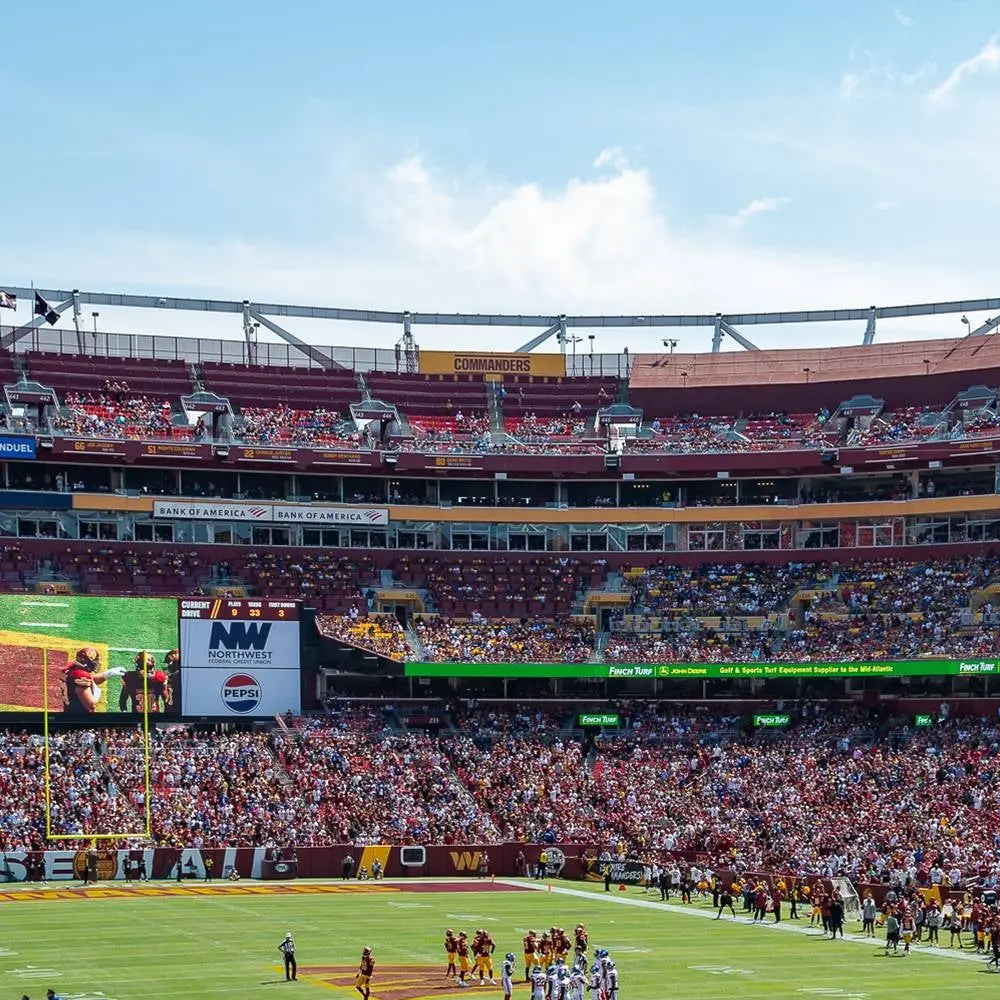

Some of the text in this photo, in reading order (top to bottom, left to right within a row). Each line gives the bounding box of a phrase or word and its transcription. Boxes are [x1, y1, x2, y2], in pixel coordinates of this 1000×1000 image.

[454, 358, 531, 372] COMMANDERS
[0, 443, 33, 453] NDUEL
[75, 441, 85, 450] 66
[160, 507, 186, 515] BANK
[203, 509, 246, 518] AMERICA
[278, 511, 303, 519] BANK
[320, 513, 362, 521] AMERICA
[182, 610, 200, 618] DRIVE
[279, 609, 284, 617] 3
[208, 622, 272, 650] NW
[208, 651, 272, 659] NORTHWEST
[609, 666, 633, 676] FINCH
[634, 665, 653, 675] TURF
[742, 666, 762, 674] Sports
[764, 665, 777, 673] Turf
[779, 665, 812, 674] Equipment
[814, 665, 839, 674] Supplier
[848, 665, 858, 673] the
[860, 664, 893, 673] Mid-Atlantic
[959, 662, 980, 671] FINCH
[980, 661, 995, 670] TURF
[224, 689, 259, 698] PEPSI
[582, 715, 601, 723] FINCH
